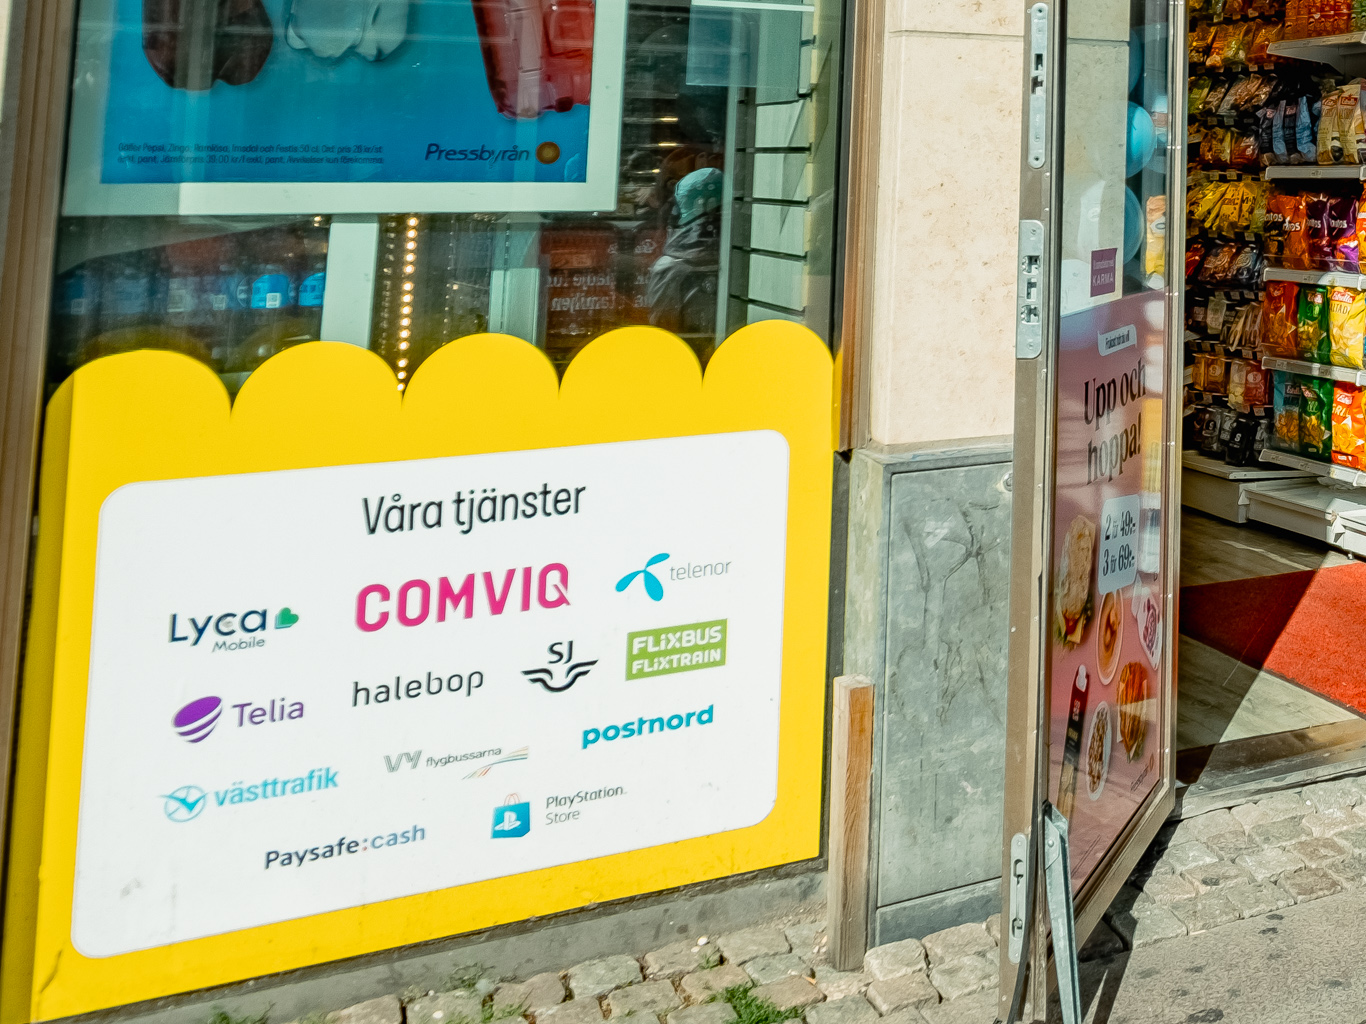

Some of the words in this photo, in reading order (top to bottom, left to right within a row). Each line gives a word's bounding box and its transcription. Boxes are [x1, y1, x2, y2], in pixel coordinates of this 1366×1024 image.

[425, 143, 530, 167] Pressbyrån
[1092, 273, 1114, 287] KARMA
[1332, 291, 1355, 303] Estrella
[1084, 378, 1117, 431] Upp
[1119, 358, 1147, 406] och
[1086, 412, 1142, 485] hoppa!
[362, 494, 443, 535] Våra
[452, 483, 586, 534] tjänster
[1104, 513, 1111, 542] 2
[669, 561, 732, 581] telenor
[1102, 548, 1109, 577] 3
[355, 562, 571, 632] COMVIQ
[168, 608, 268, 646] Lyca
[212, 636, 266, 653] Mobile
[547, 640, 574, 664] SJ
[351, 670, 485, 707] halebop
[231, 698, 305, 728] Telia
[581, 704, 714, 749] postnord
[426, 747, 502, 768] flygbussarna
[213, 767, 339, 807] västtrafik
[546, 785, 624, 809] PlayStation
[545, 809, 580, 826] Store
[264, 825, 426, 870] Paysafe:cash
